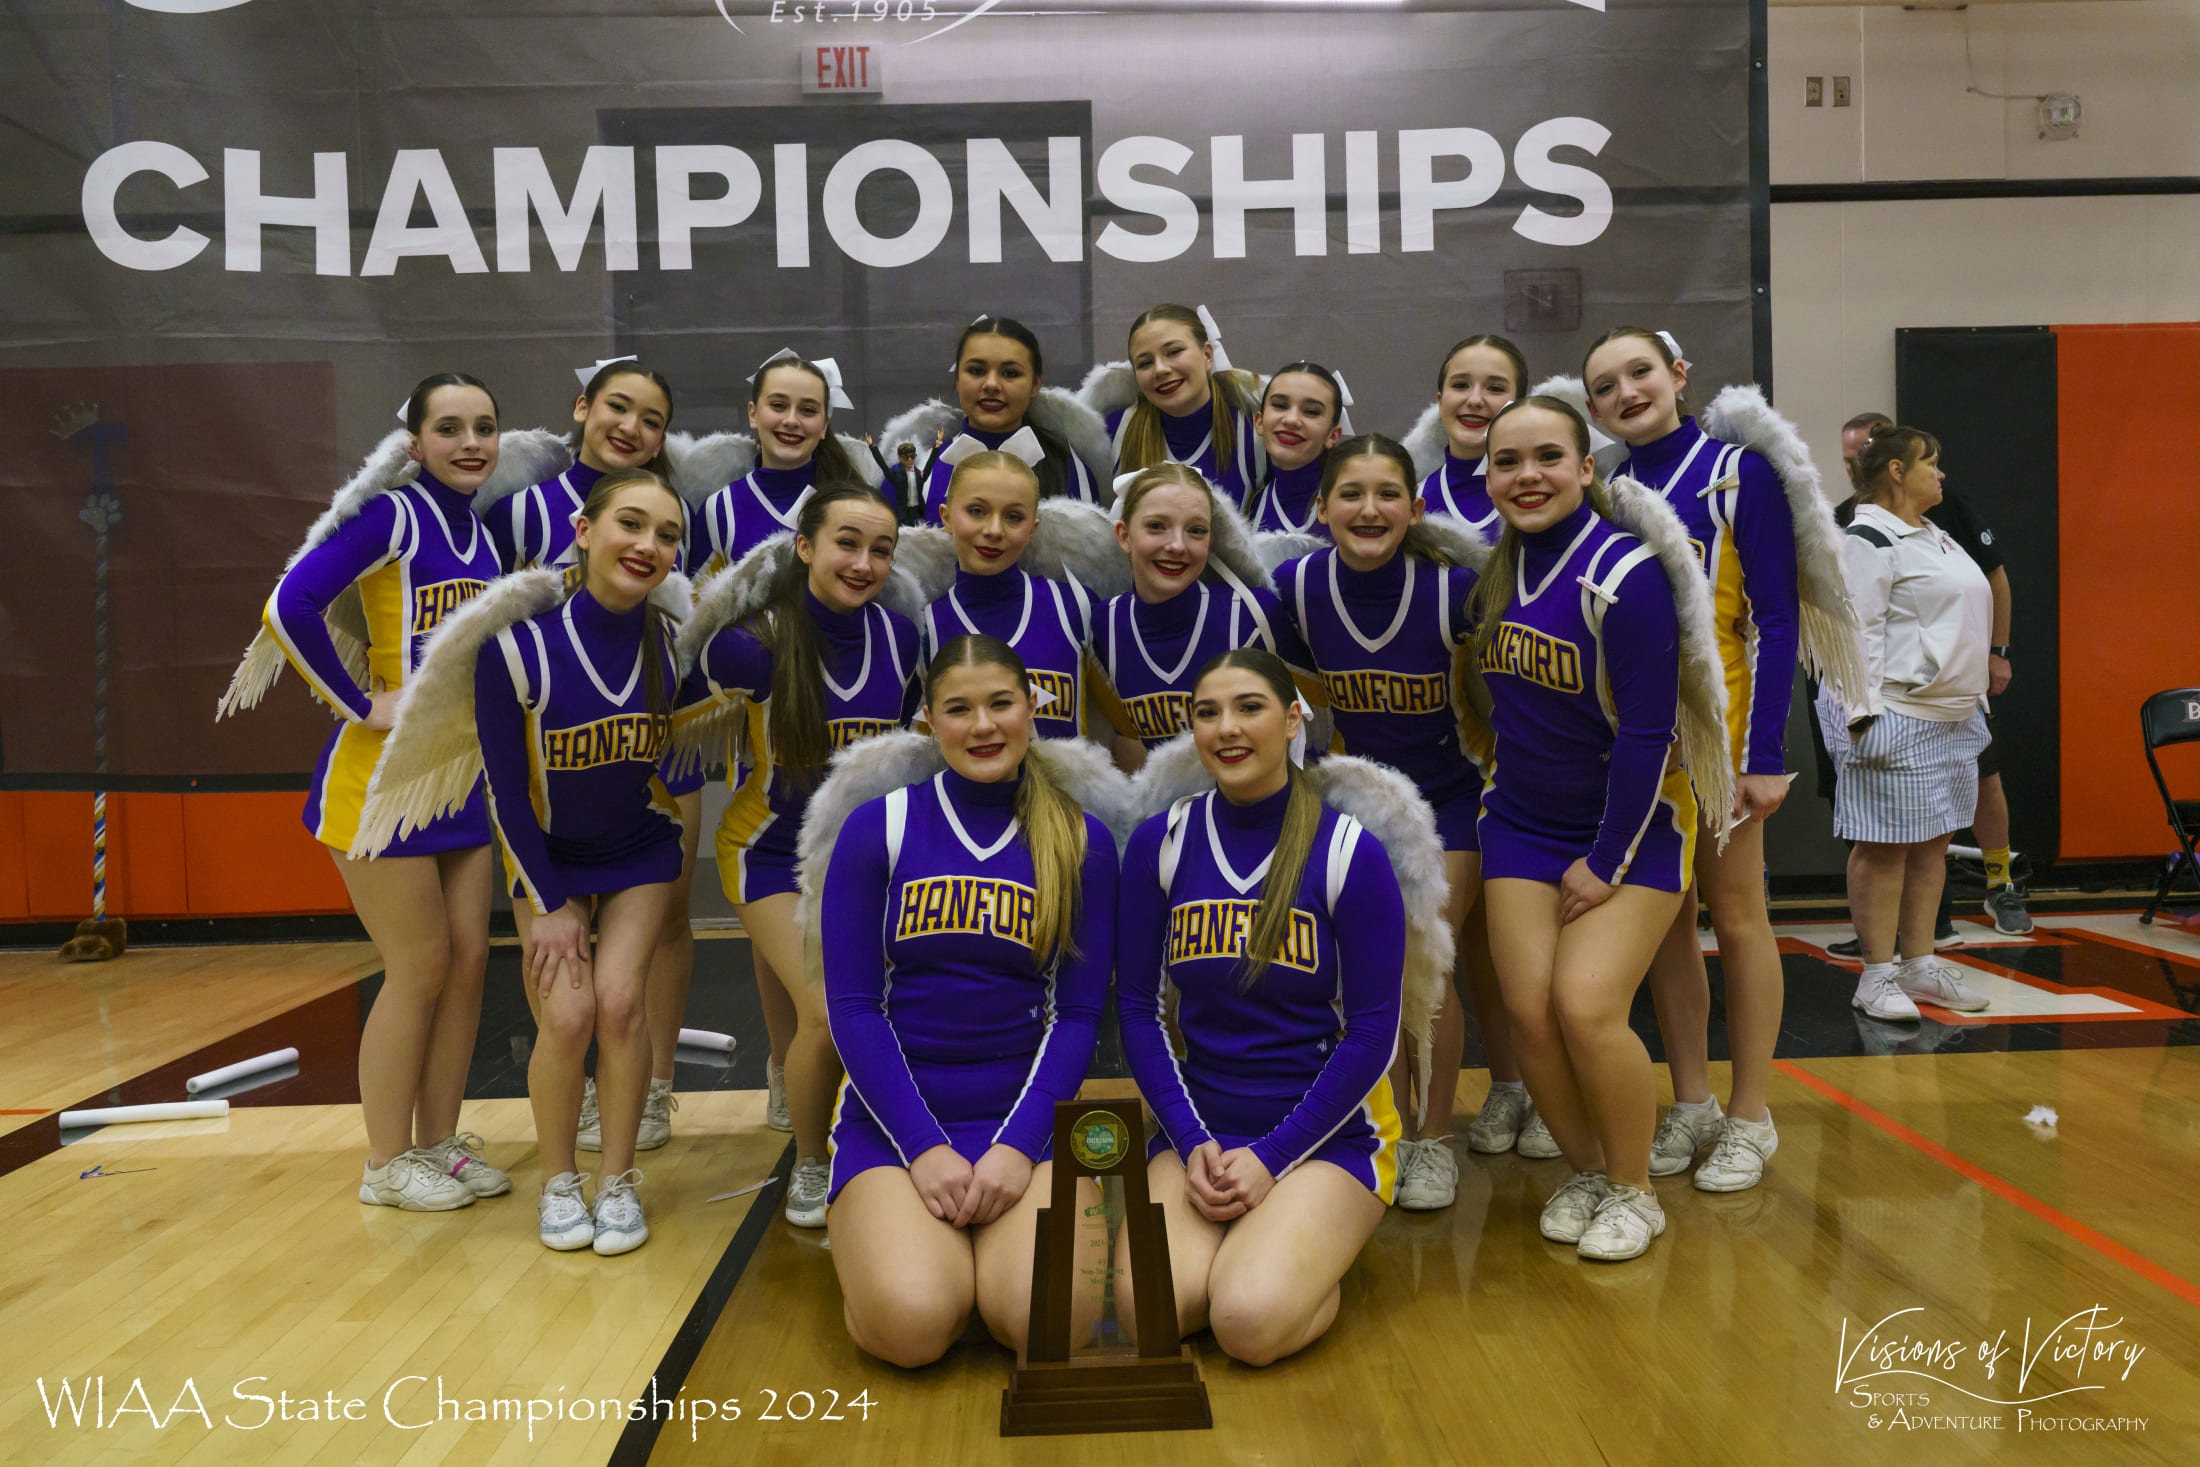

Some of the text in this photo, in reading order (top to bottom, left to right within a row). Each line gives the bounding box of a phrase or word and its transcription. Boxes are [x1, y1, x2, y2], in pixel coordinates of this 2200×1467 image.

[816, 46, 870, 89] EXIT
[82, 116, 1614, 277] CHAMPIONSHIPS
[896, 875, 1038, 950] HANFOR
[1169, 899, 1319, 974] HANFD
